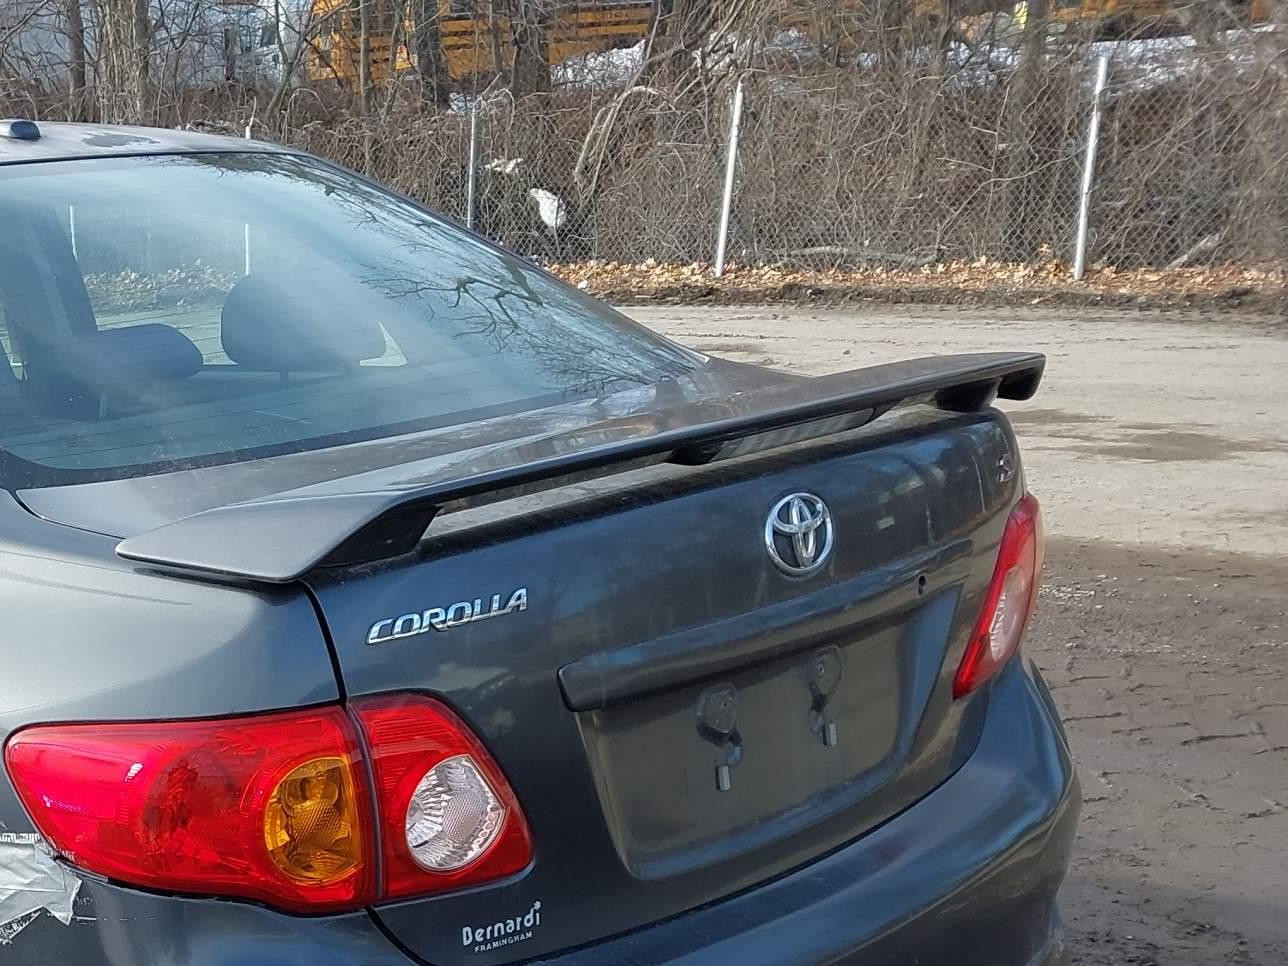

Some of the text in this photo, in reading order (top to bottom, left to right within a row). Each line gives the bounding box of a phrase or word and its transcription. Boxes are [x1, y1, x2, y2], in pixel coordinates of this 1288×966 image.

[367, 587, 528, 645] COROLLA
[461, 902, 541, 947] Bernardi
[474, 930, 533, 954] FRAMINGHAM
